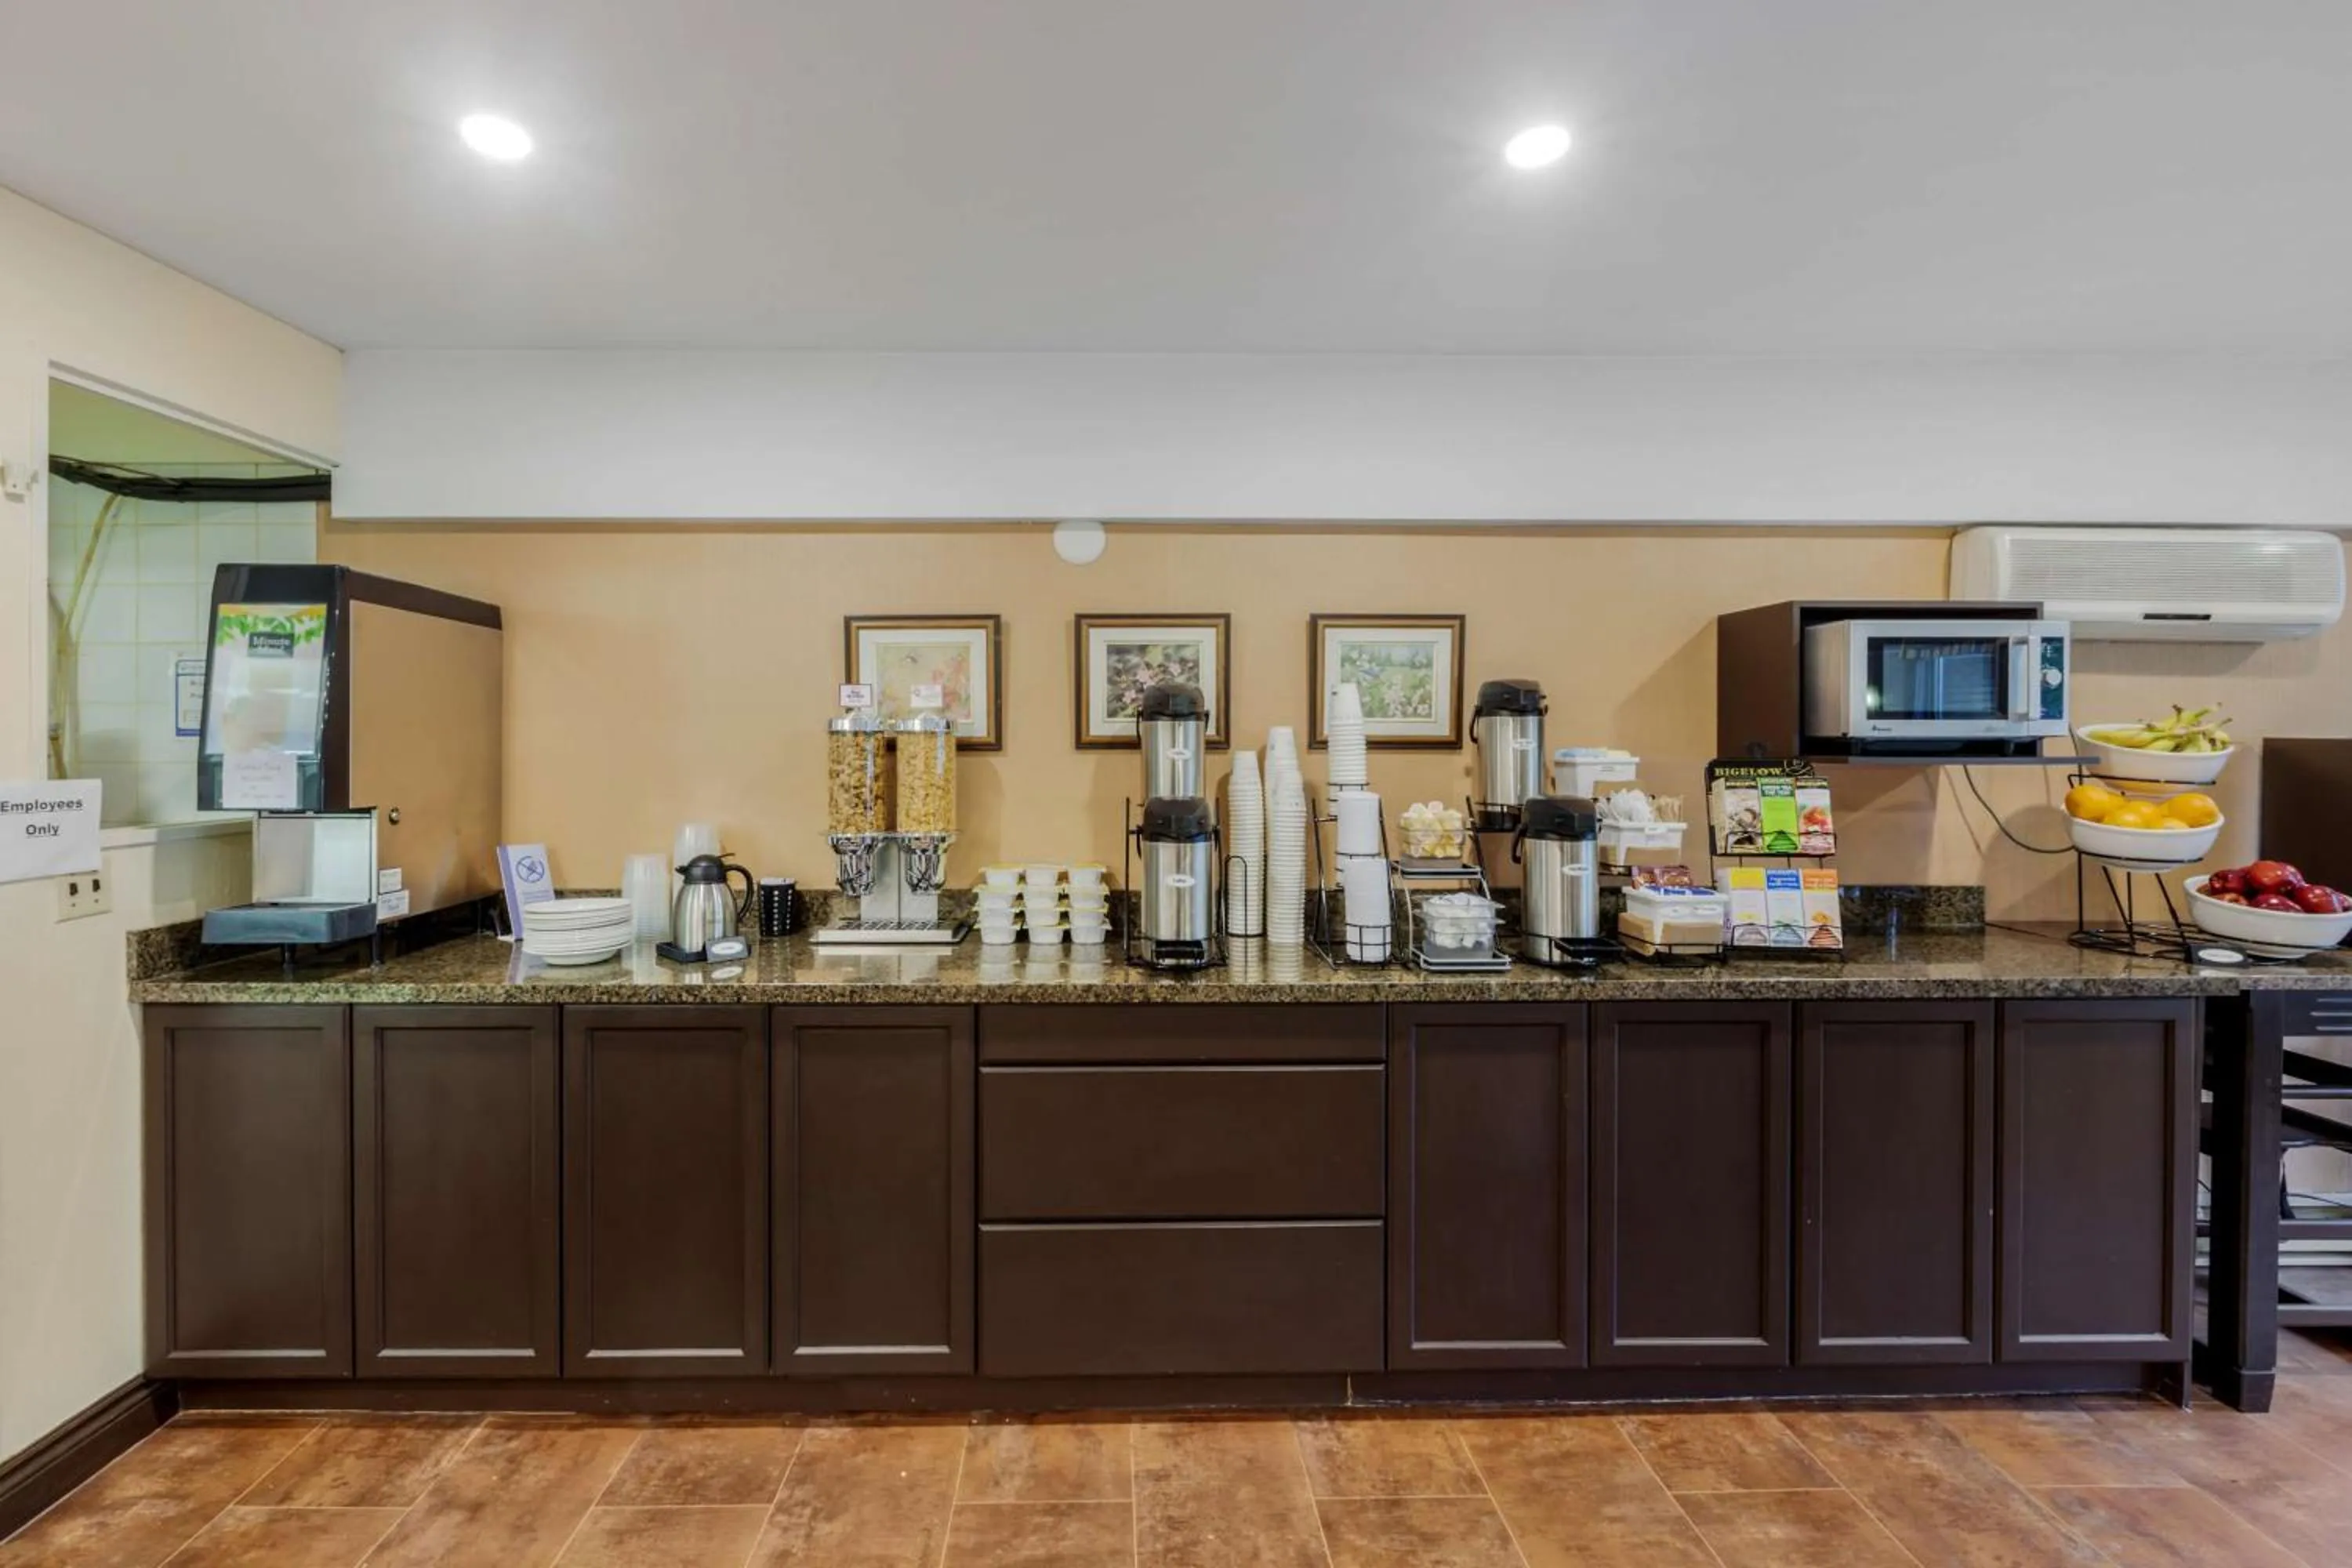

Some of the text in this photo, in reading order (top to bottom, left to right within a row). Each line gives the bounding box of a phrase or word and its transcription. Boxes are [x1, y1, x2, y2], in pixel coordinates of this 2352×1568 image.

[1714, 768, 1782, 776] BIGELOW
[1, 800, 83, 813] Employees
[26, 823, 60, 837] Only
